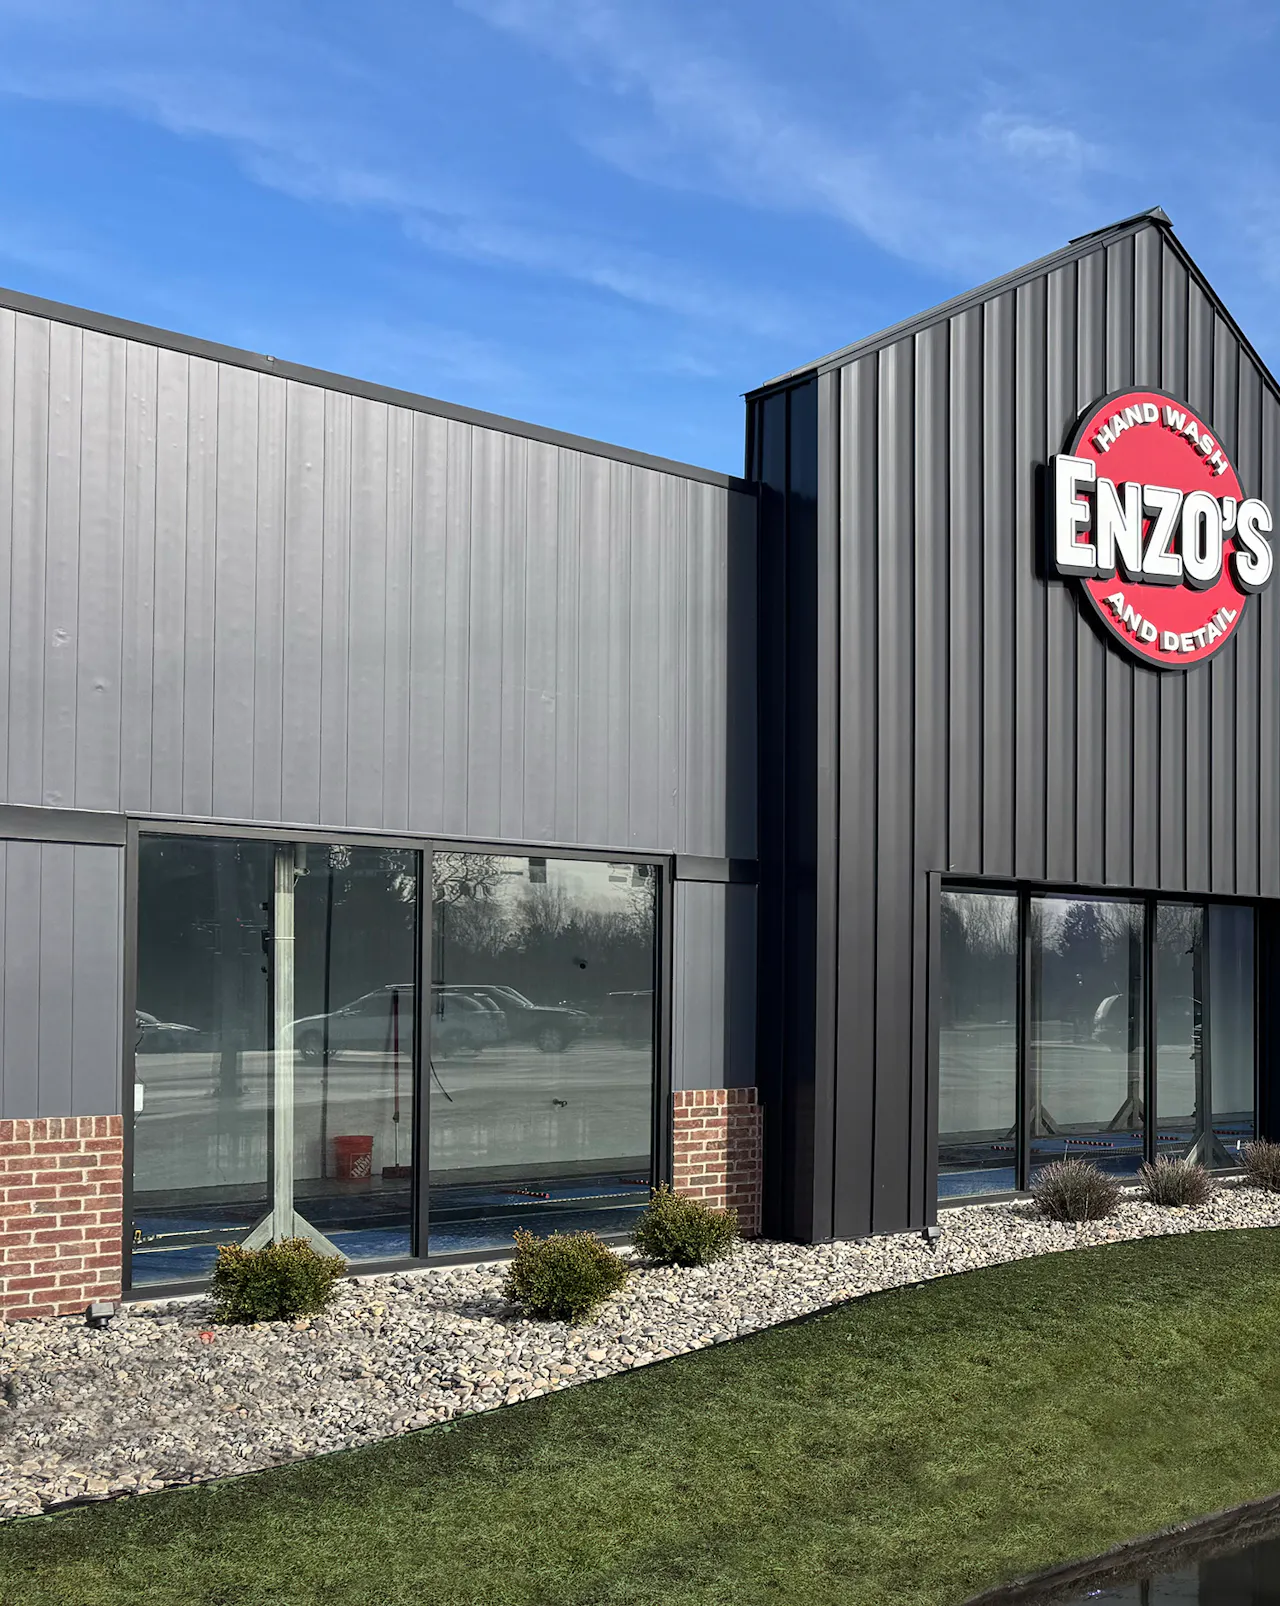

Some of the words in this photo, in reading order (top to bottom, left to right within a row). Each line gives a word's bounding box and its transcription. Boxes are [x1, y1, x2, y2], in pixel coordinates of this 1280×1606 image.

[1094, 403, 1159, 452] HAND
[1164, 405, 1229, 475] WASH
[1054, 453, 1274, 586] ENZO'S
[1106, 591, 1158, 642] AND
[1163, 607, 1237, 652] DETAIL
